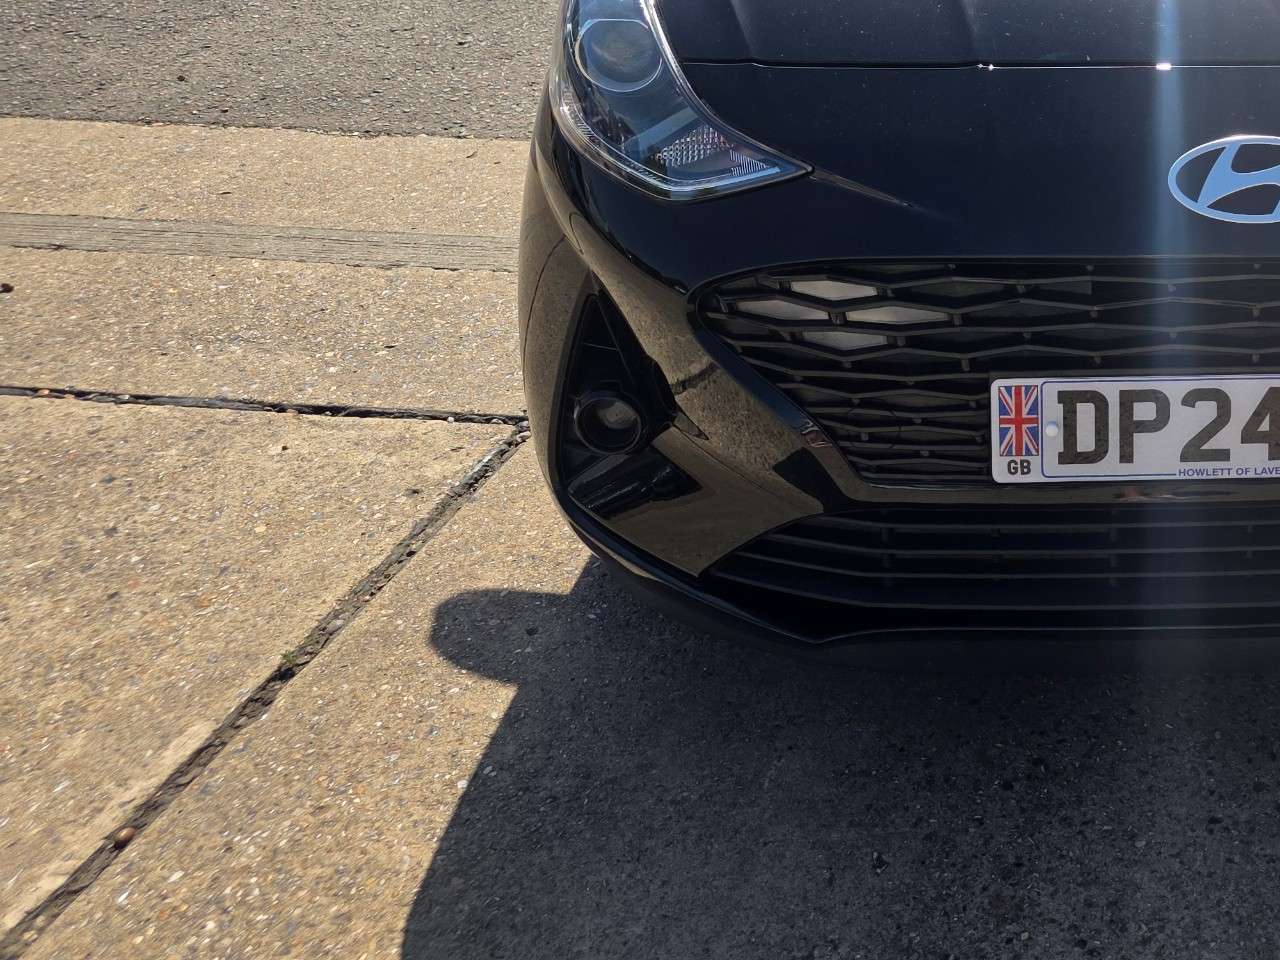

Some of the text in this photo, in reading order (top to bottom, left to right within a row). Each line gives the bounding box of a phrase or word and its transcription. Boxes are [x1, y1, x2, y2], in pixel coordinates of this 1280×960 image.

[1007, 459, 1031, 476] GB
[1178, 467, 1233, 477] HOWLETT
[1235, 467, 1250, 476] OF
